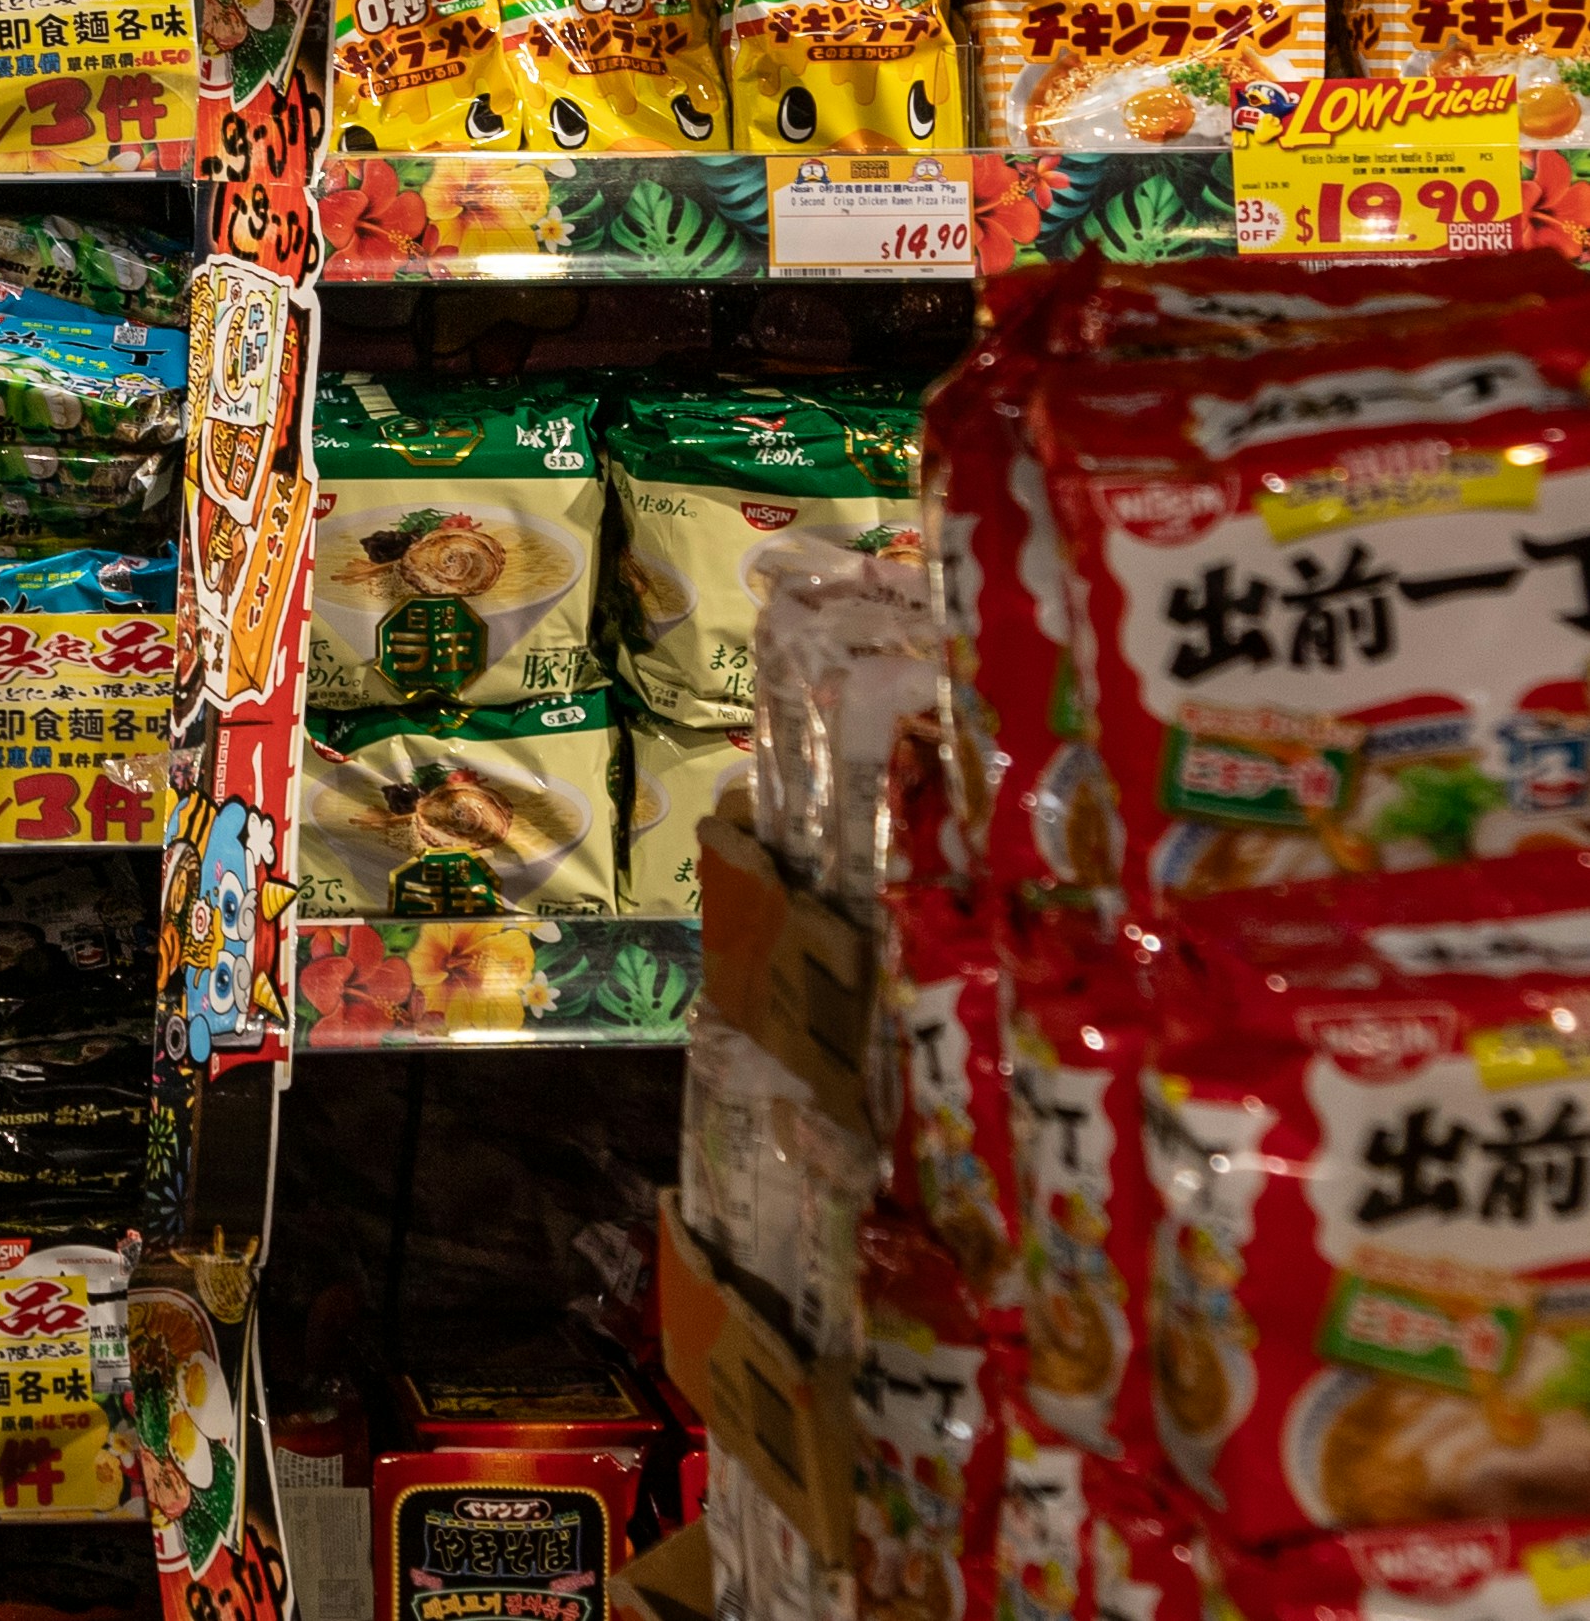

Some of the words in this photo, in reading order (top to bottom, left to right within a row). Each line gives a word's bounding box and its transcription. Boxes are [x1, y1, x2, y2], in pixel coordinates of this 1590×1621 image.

[1023, 3, 1296, 58] チキンラーメン
[1392, 74, 1516, 122] Price!!
[1479, 153, 1494, 162] PCS
[800, 197, 825, 206] Second
[833, 197, 854, 207] Crisp
[858, 197, 888, 206] Chicken
[917, 196, 938, 205] Pizza
[942, 196, 967, 205] Flavor
[1238, 200, 1280, 226] 33%
[1295, 180, 1499, 244] $19.90
[881, 224, 967, 259] $14.90
[1240, 230, 1276, 242] OFF
[1449, 235, 1513, 251] DONKI
[548, 454, 580, 469] 5食入
[746, 508, 792, 524] NISSIN
[547, 709, 583, 726] 5食入
